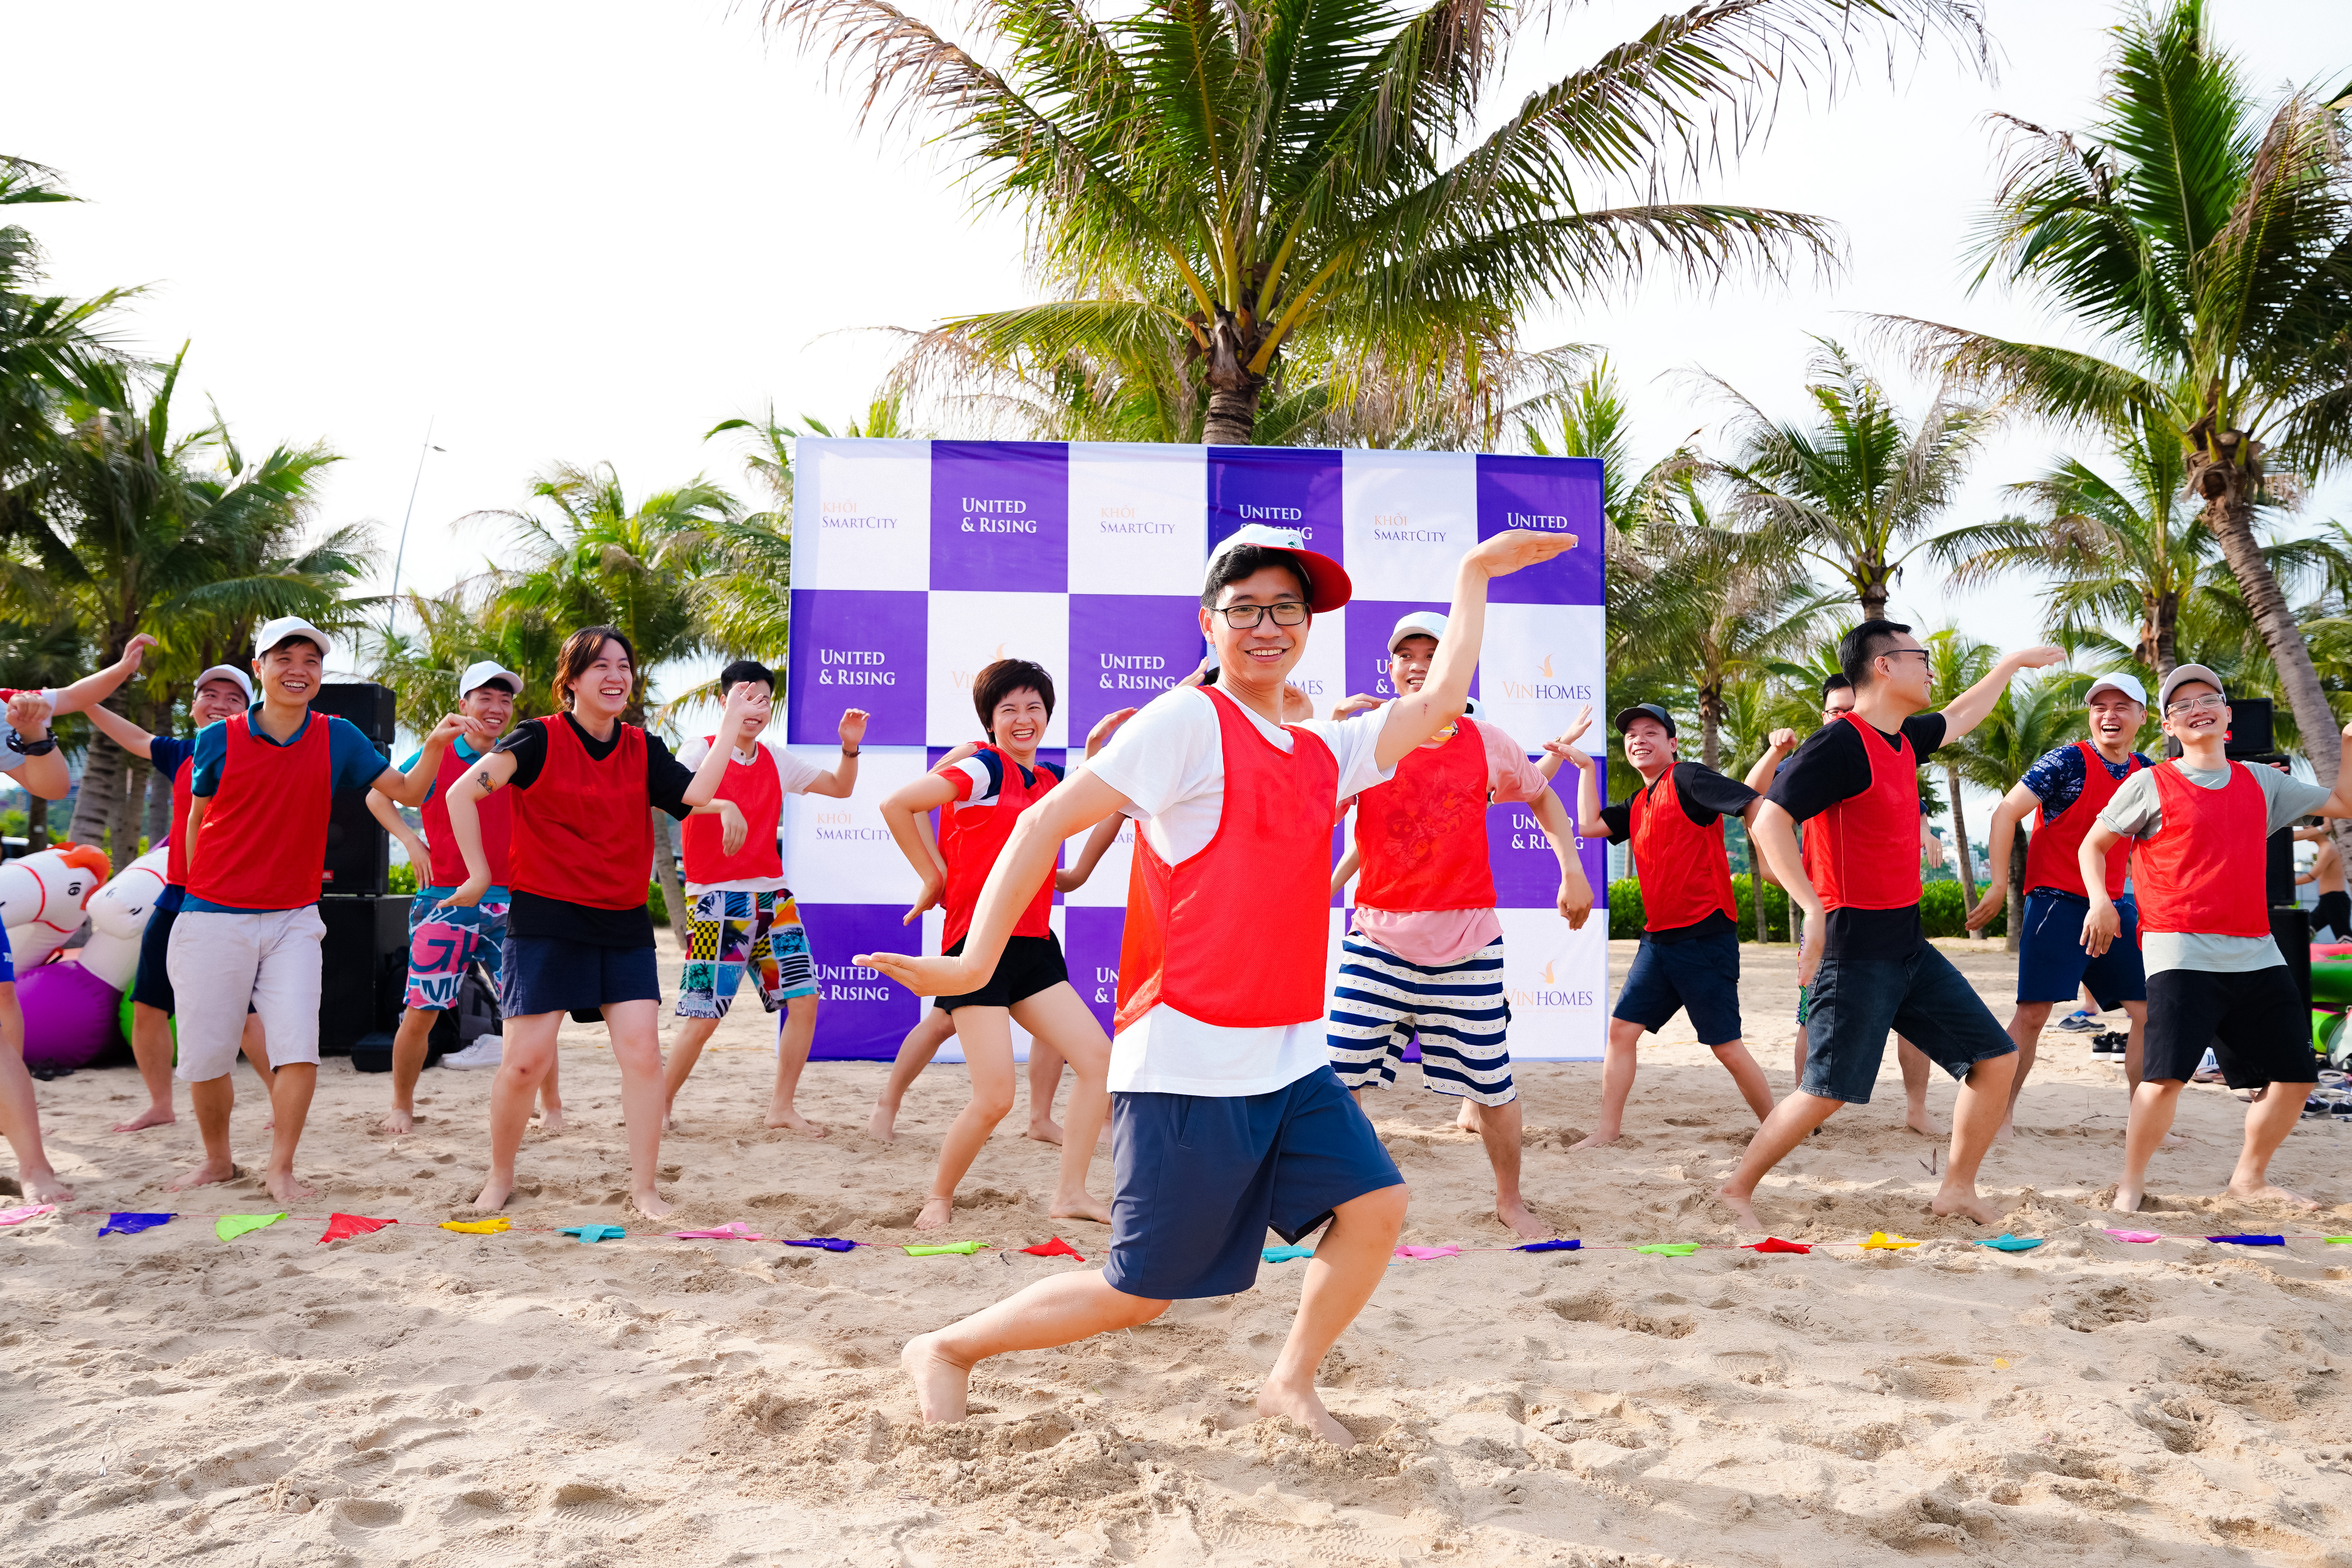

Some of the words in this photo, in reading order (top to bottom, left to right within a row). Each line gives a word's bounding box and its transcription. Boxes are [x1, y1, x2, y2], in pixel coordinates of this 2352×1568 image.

[961, 517, 976, 533] &
[819, 669, 834, 685] &
[1099, 673, 1114, 689] &
[1376, 678, 1390, 694] &
[1512, 834, 1525, 849] &
[1094, 987, 1110, 1004] &
